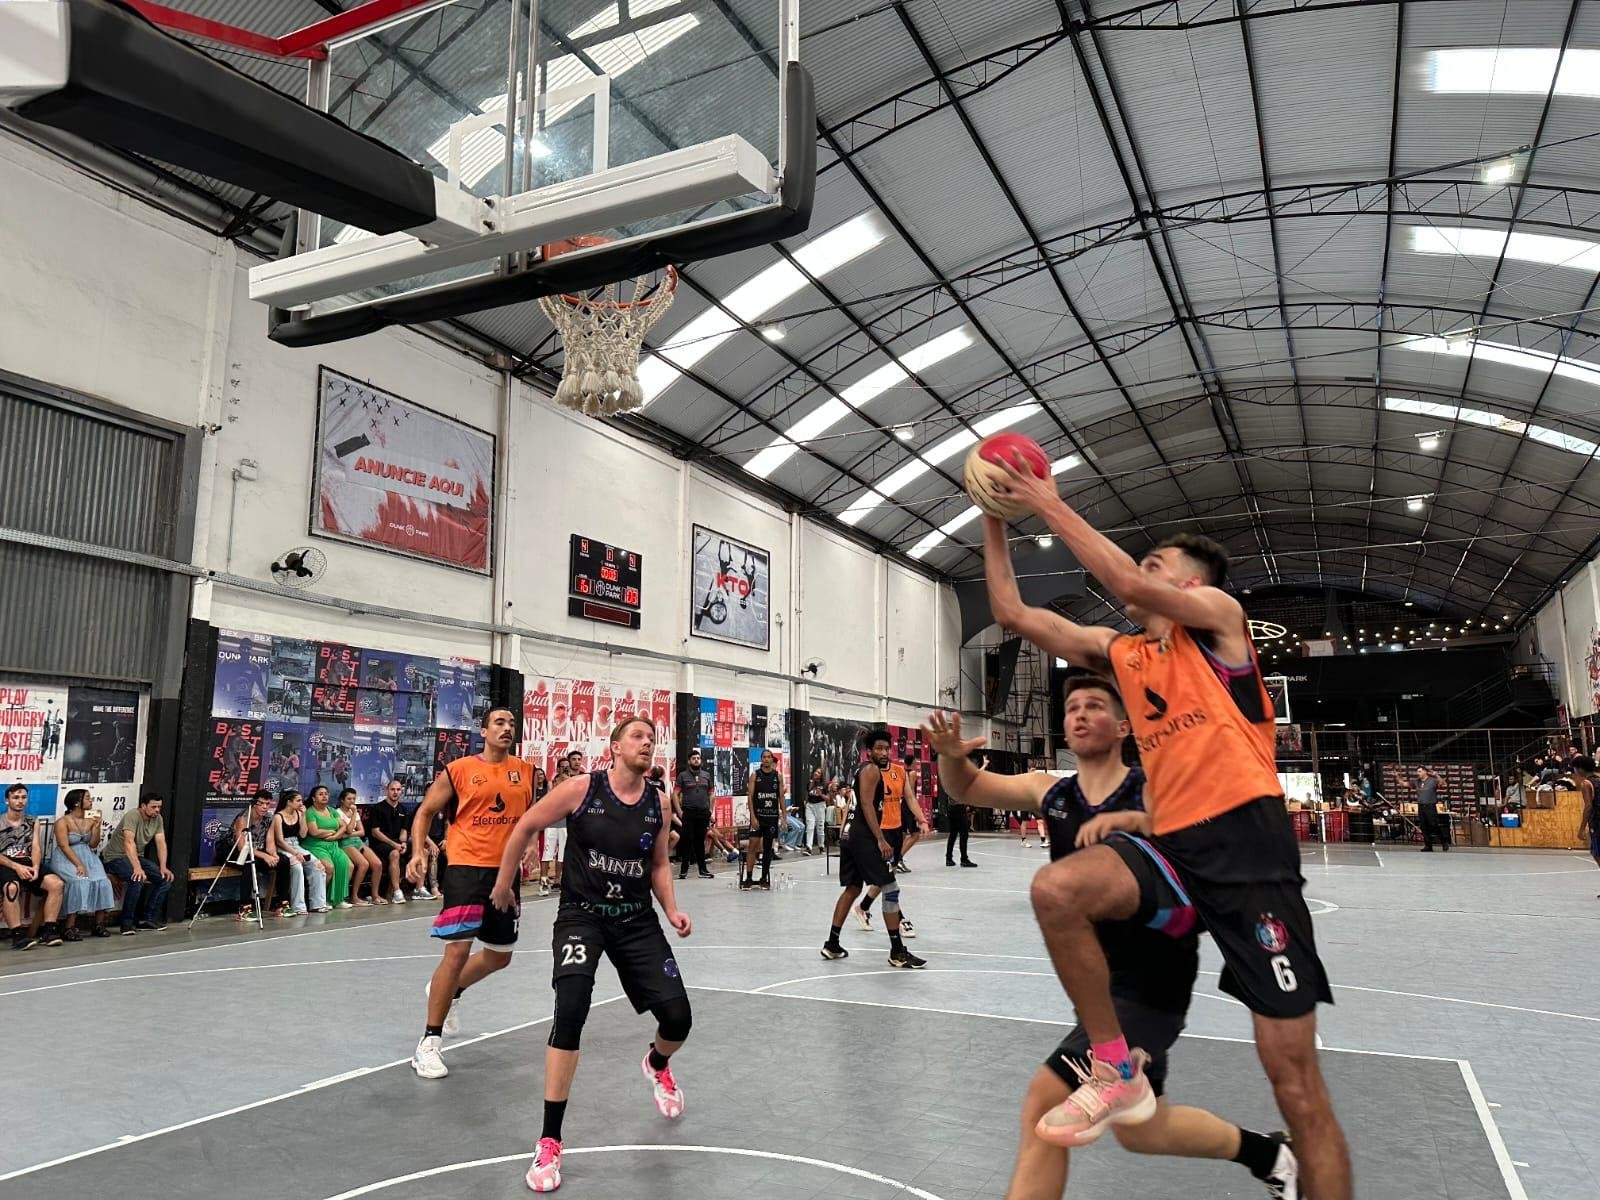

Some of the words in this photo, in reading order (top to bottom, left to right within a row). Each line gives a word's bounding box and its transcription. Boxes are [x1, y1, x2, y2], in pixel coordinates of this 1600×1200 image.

[354, 456, 427, 488] ANUNCIE
[428, 475, 465, 497] AQUI
[389, 522, 406, 531] DUNK
[605, 583, 621, 593] DUNK
[717, 572, 752, 597] KTO
[604, 590, 621, 600] PARK
[220, 629, 239, 637] BEX
[254, 634, 272, 642] BEX
[571, 678, 595, 696] Bud
[0, 688, 28, 706] PLAY
[524, 690, 548, 706] Bud
[652, 689, 671, 703] Bud
[614, 697, 635, 713] Bud
[522, 718, 548, 741] NBA
[569, 720, 593, 742] NBA
[113, 796, 126, 810] 23
[588, 849, 644, 878] SAINTS
[561, 943, 587, 966] 23
[1270, 954, 1298, 993] 6
